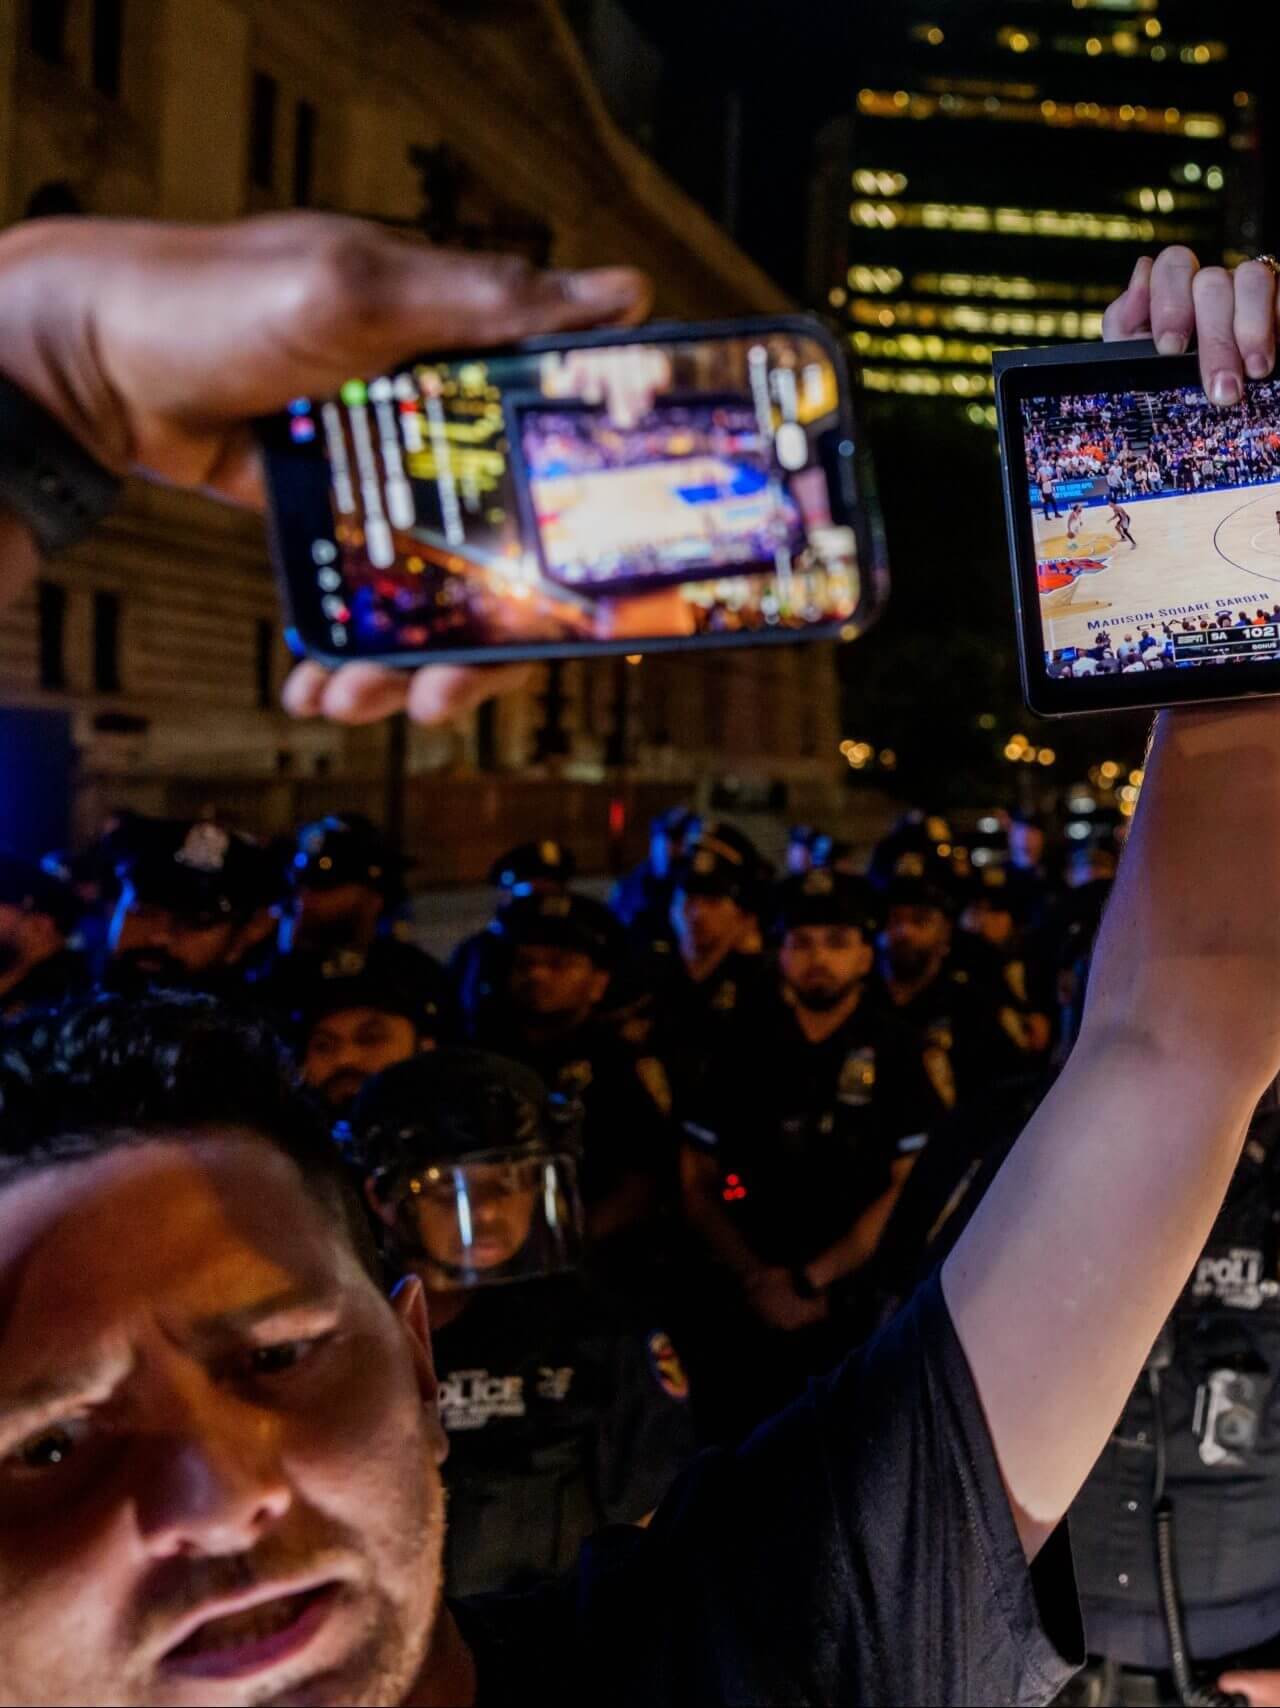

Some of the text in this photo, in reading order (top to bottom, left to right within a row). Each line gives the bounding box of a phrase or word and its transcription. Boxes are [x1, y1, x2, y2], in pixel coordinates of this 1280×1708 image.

[1087, 592, 1270, 631] MADISON SQUARE GARDEN
[1242, 626, 1275, 639] 102
[1252, 642, 1277, 650] BONUS
